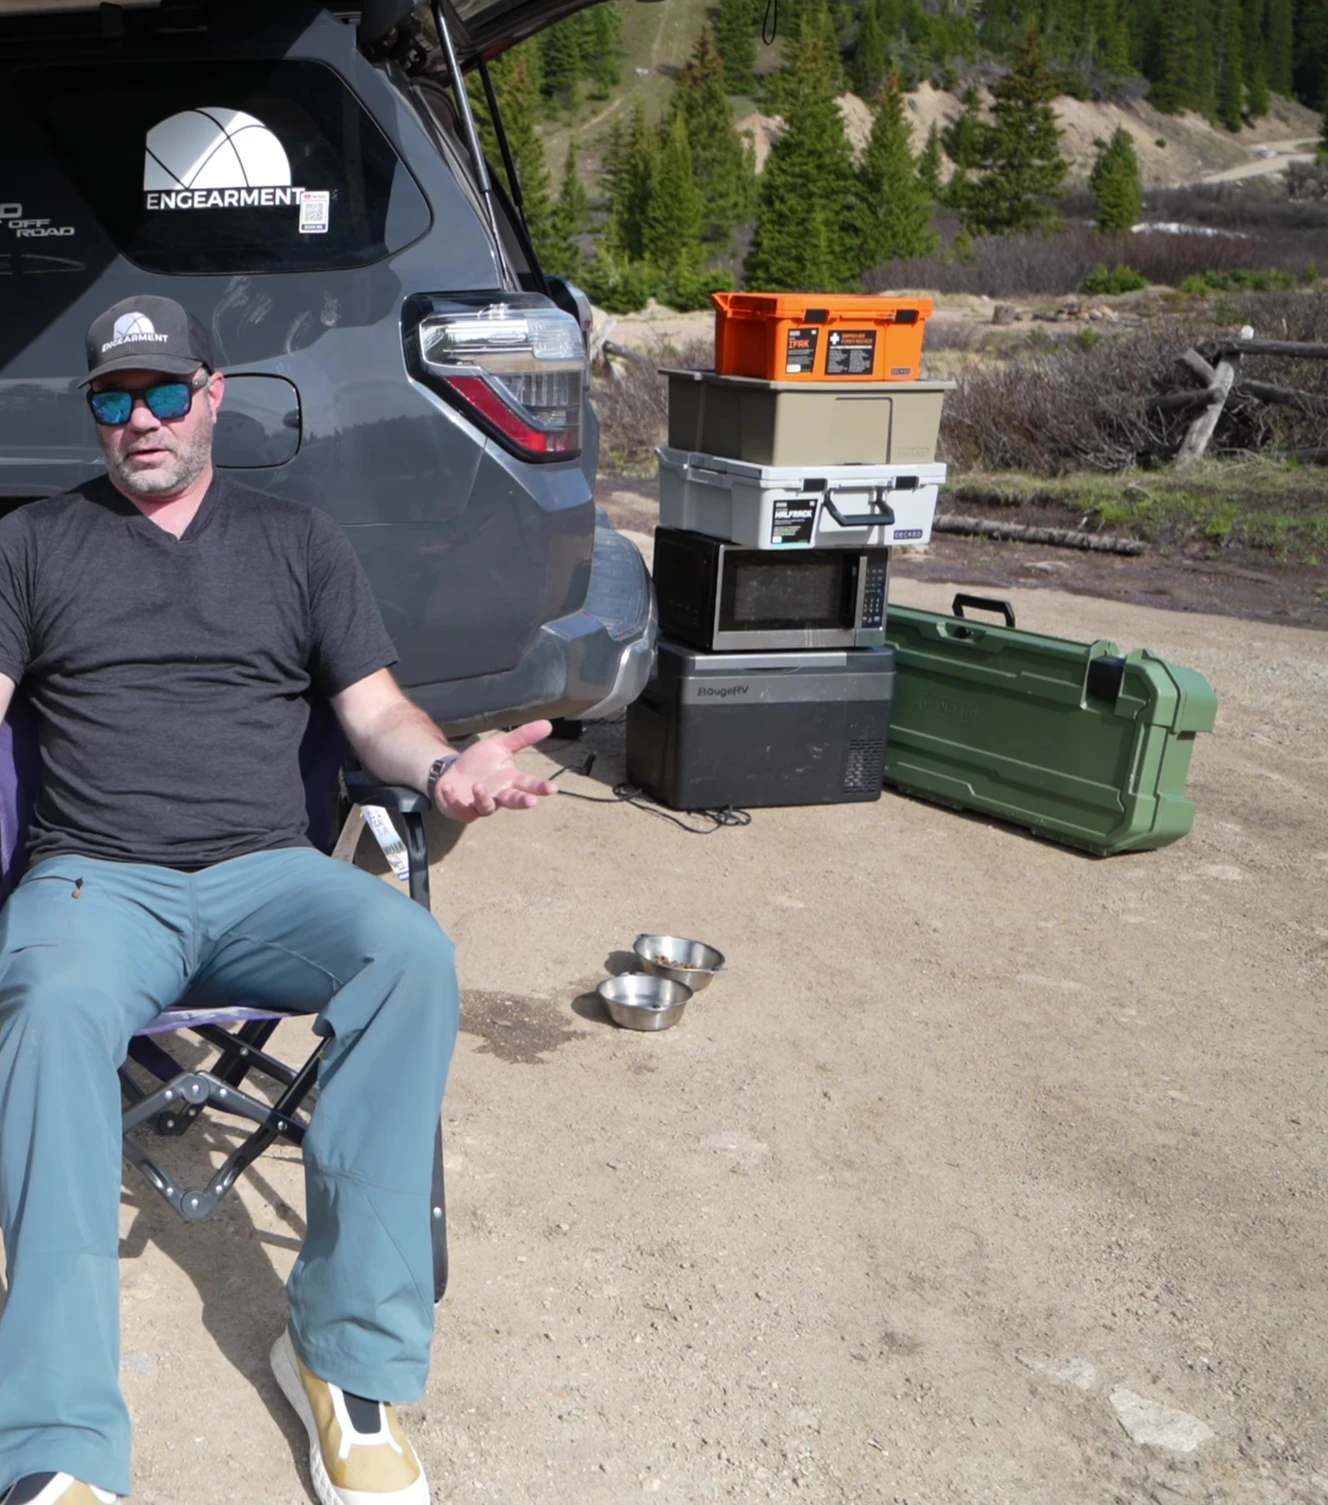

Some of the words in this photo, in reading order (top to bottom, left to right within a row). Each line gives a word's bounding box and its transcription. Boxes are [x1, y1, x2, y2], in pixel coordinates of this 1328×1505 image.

[146, 187, 305, 210] ENGEARMENT
[8, 218, 51, 229] OFF
[16, 226, 75, 238] ROAD
